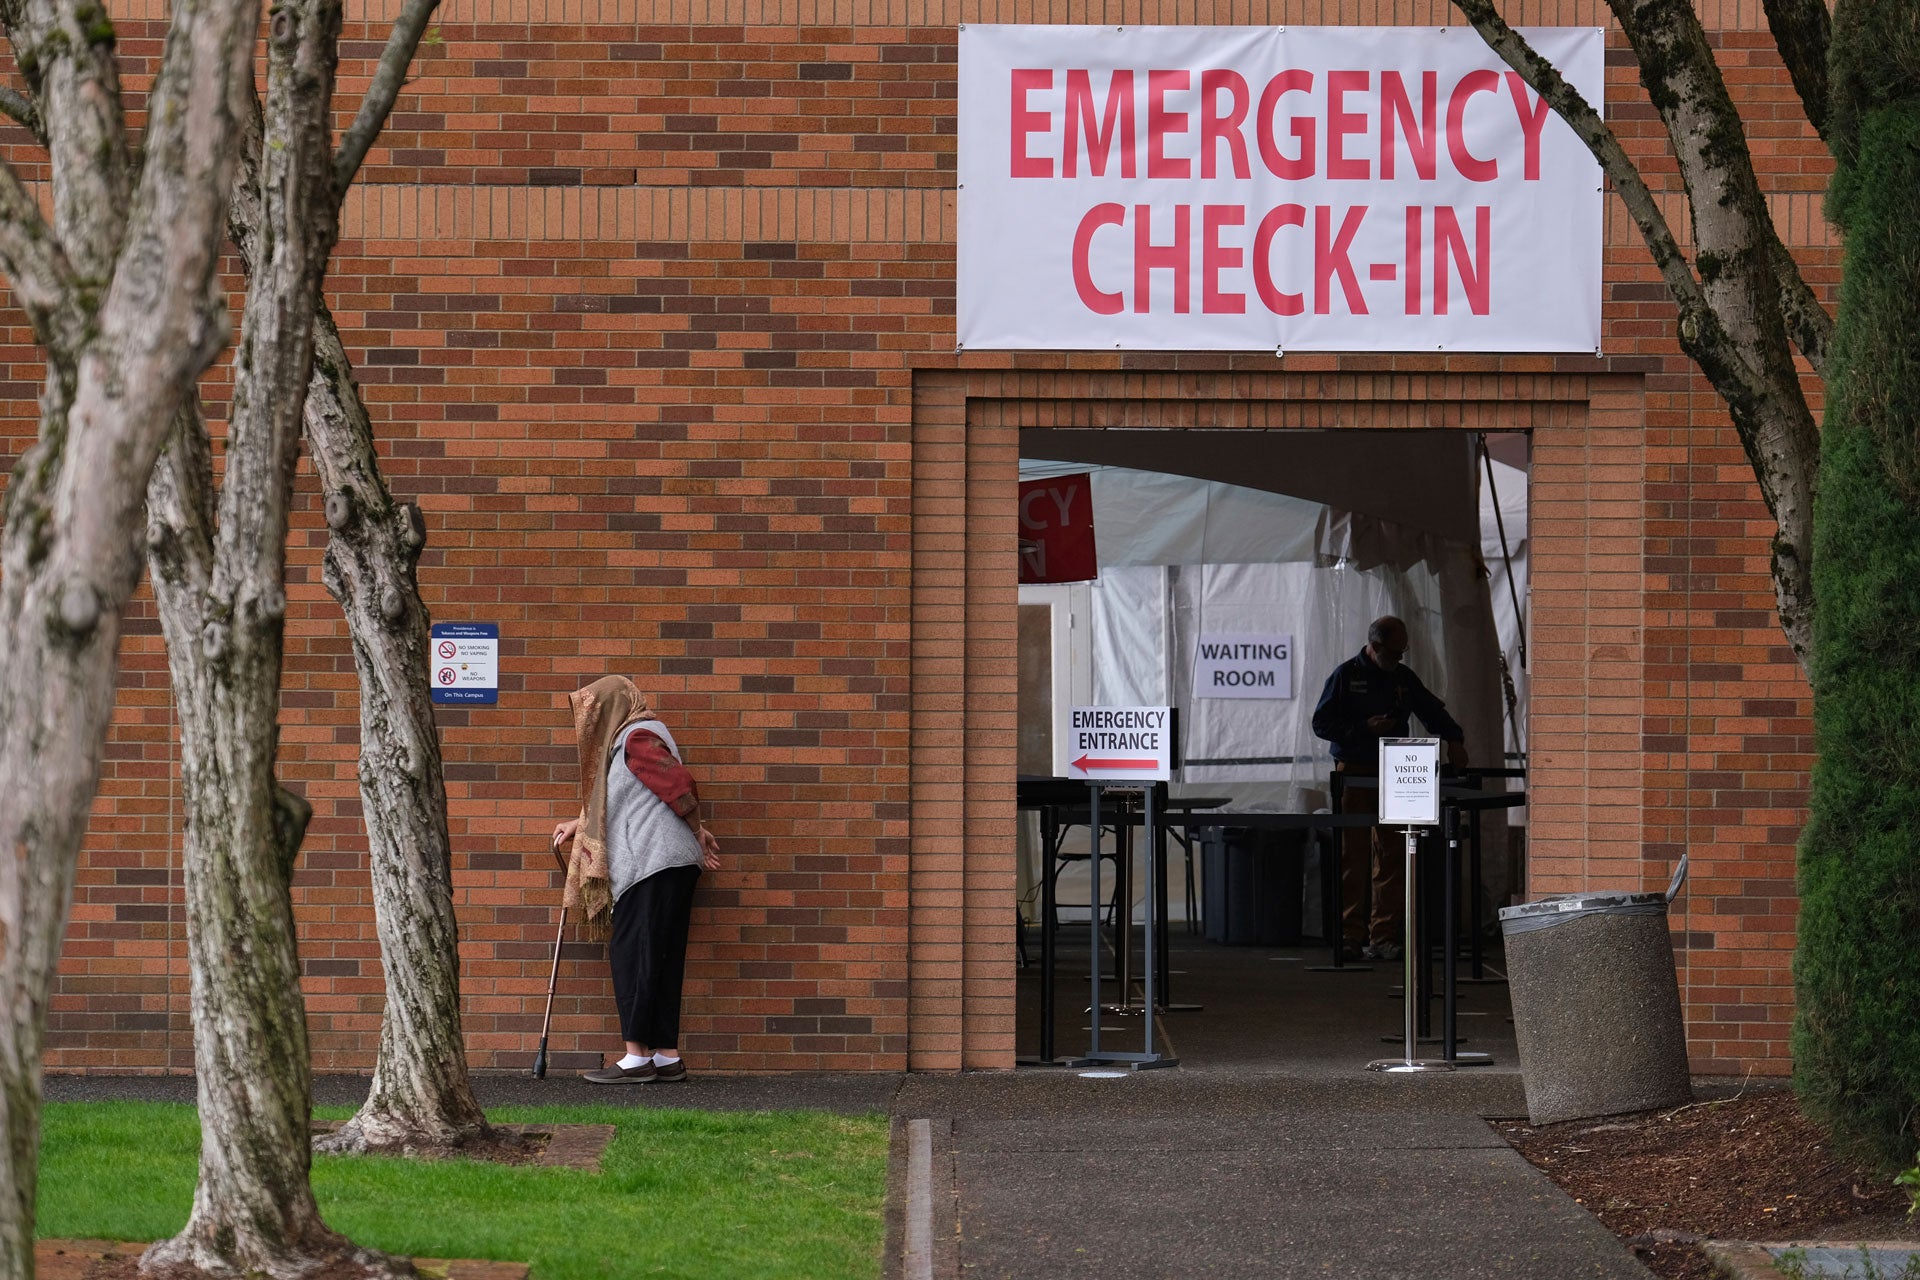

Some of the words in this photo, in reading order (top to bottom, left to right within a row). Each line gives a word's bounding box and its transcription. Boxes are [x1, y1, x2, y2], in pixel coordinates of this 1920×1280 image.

[1010, 68, 1562, 182] EMERGENCY
[1071, 202, 1491, 316] CHECK-IN
[1201, 644, 1287, 660] WAITING
[1213, 670, 1275, 686] ROOM
[1072, 711, 1165, 728] EMERGENCY
[1079, 732, 1159, 750] ENTRANCE
